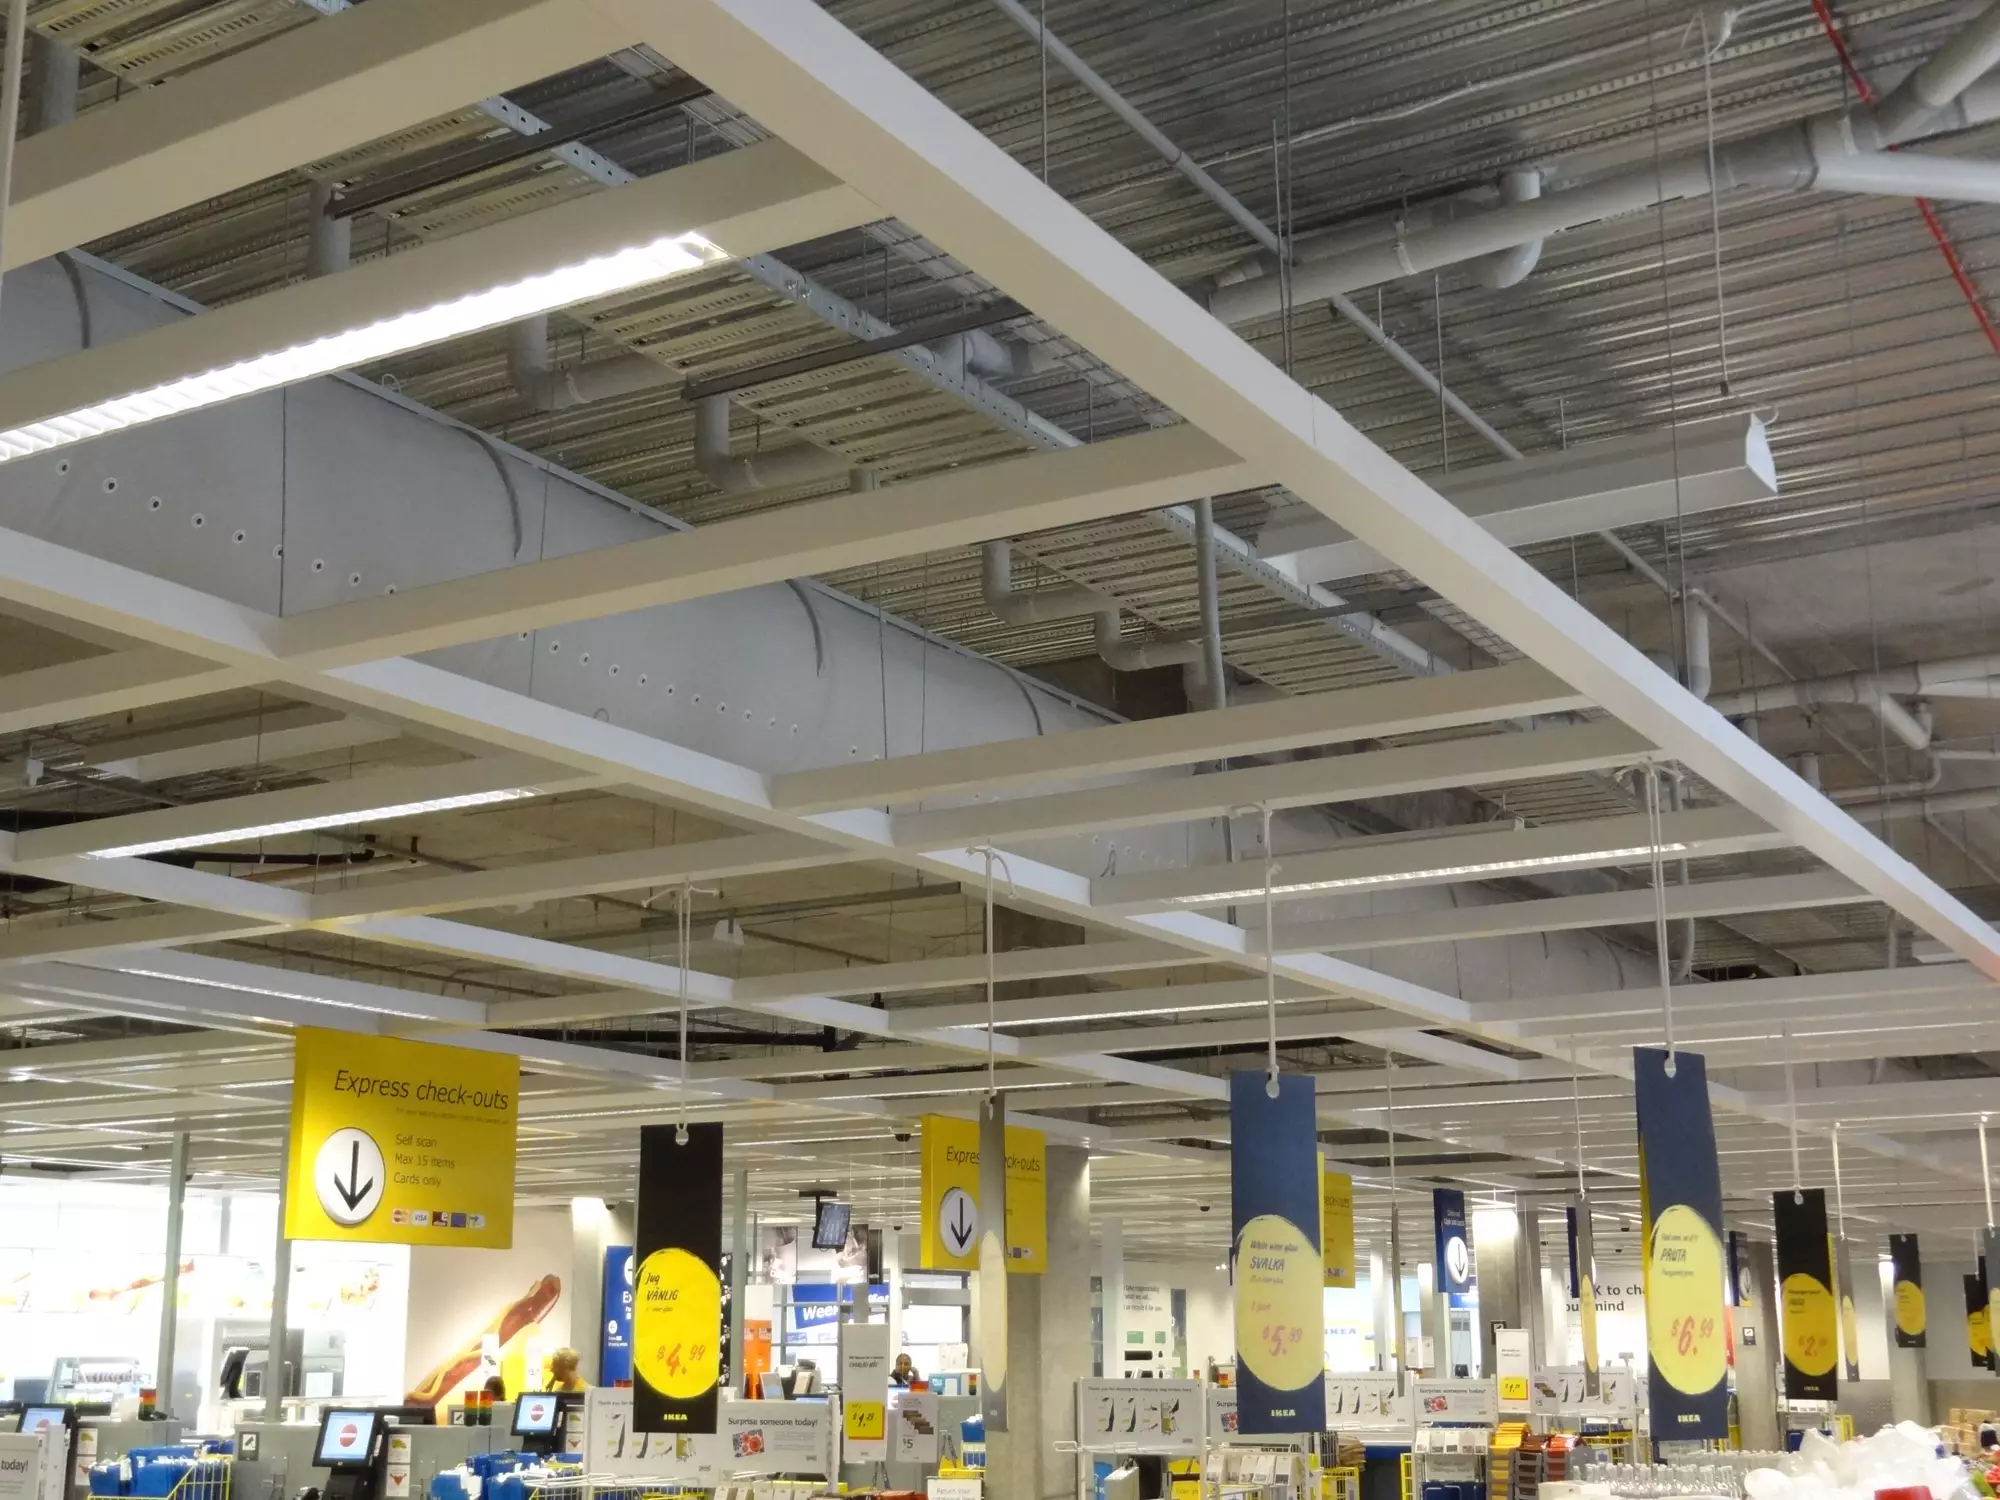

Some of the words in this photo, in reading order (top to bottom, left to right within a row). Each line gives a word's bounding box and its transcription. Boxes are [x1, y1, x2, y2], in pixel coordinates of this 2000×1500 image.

[334, 1069, 410, 1098] Express
[416, 1080, 509, 1110] check-outs
[396, 1133, 414, 1146] Self
[416, 1137, 437, 1148] scan
[394, 1153, 414, 1165] Max
[417, 1155, 428, 1166] 15
[431, 1156, 456, 1169] items
[946, 1146, 980, 1166] Expres
[1004, 1154, 1041, 1172] ck-outs
[393, 1171, 420, 1185] Cards
[423, 1176, 442, 1188] only
[414, 1213, 427, 1221] VISA
[1249, 1256, 1285, 1272] SVALKA
[645, 1272, 660, 1286] Jug
[1606, 1285, 1621, 1296] to
[663, 1413, 688, 1421] IKEA
[1271, 1409, 1296, 1417] IKEA
[1677, 1414, 1701, 1422] IKEA
[728, 1417, 758, 1427] Surprise
[795, 1417, 819, 1428] today!
[0, 1459, 29, 1474] today!
